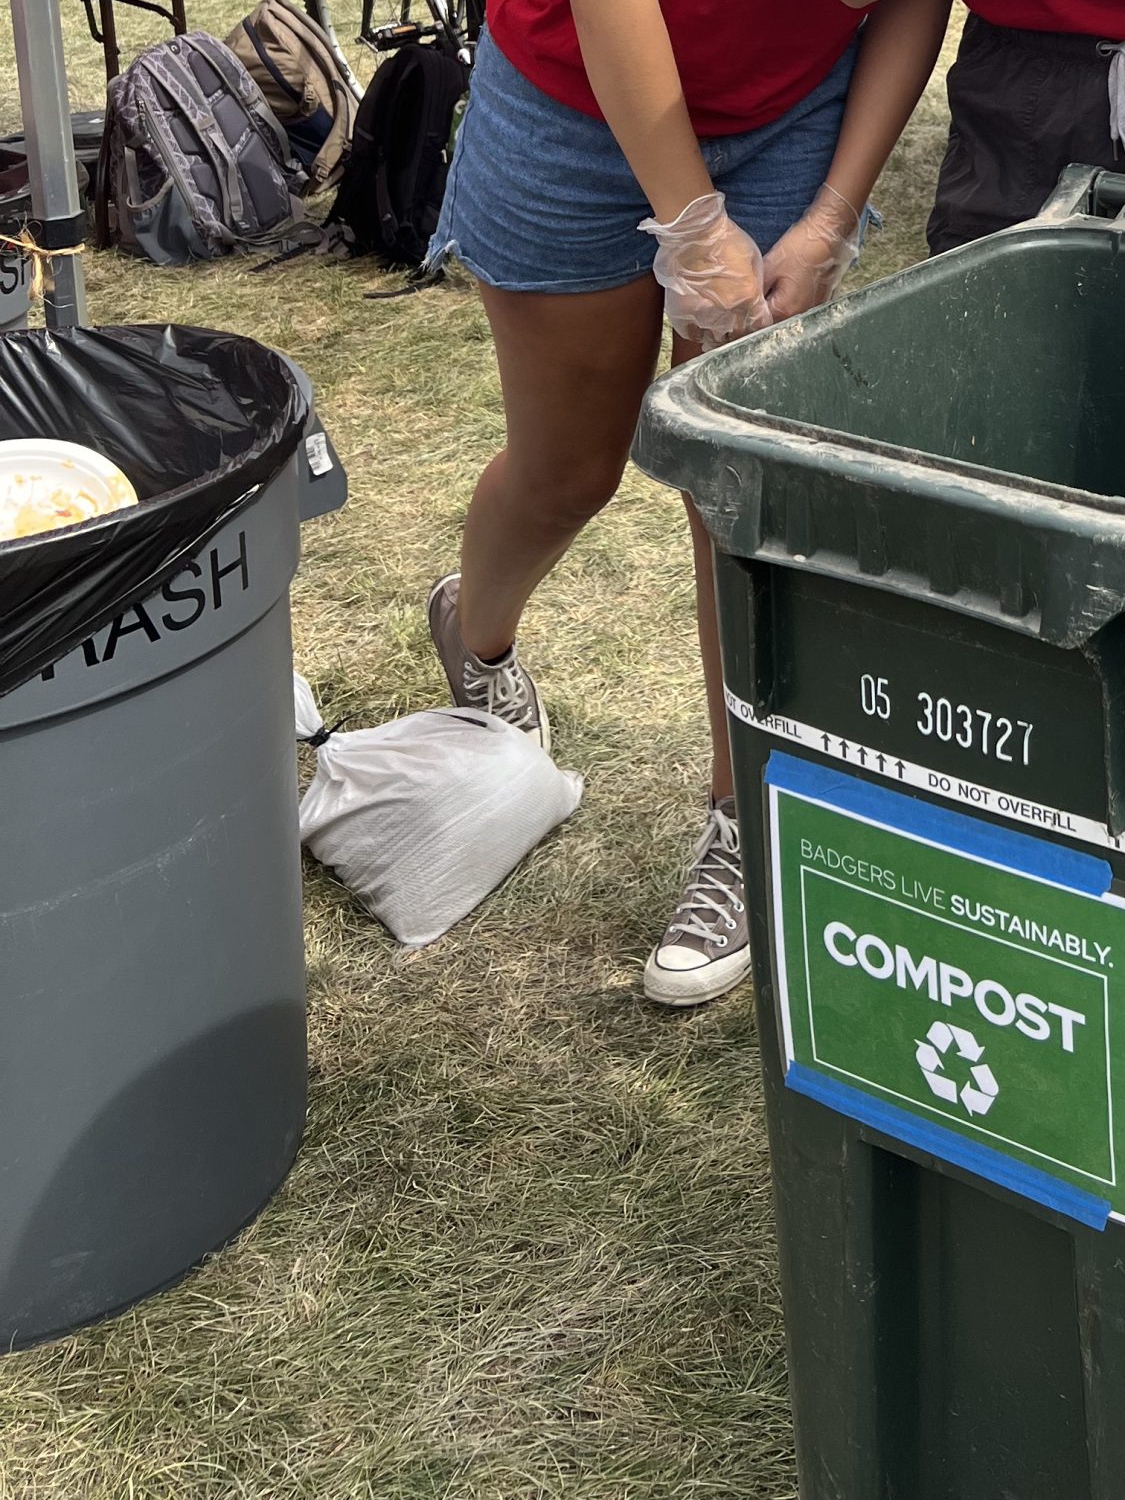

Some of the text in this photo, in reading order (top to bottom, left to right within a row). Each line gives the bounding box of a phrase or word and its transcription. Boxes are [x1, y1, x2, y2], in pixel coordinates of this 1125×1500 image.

[41, 530, 248, 682] ASH
[860, 673, 1034, 766] 05 303727
[927, 772, 1077, 833] DO NOT OVERFILL
[800, 838, 1115, 968] BADGERS LIVE SUSTAINABLY.
[822, 920, 1086, 1053] COMPOST
